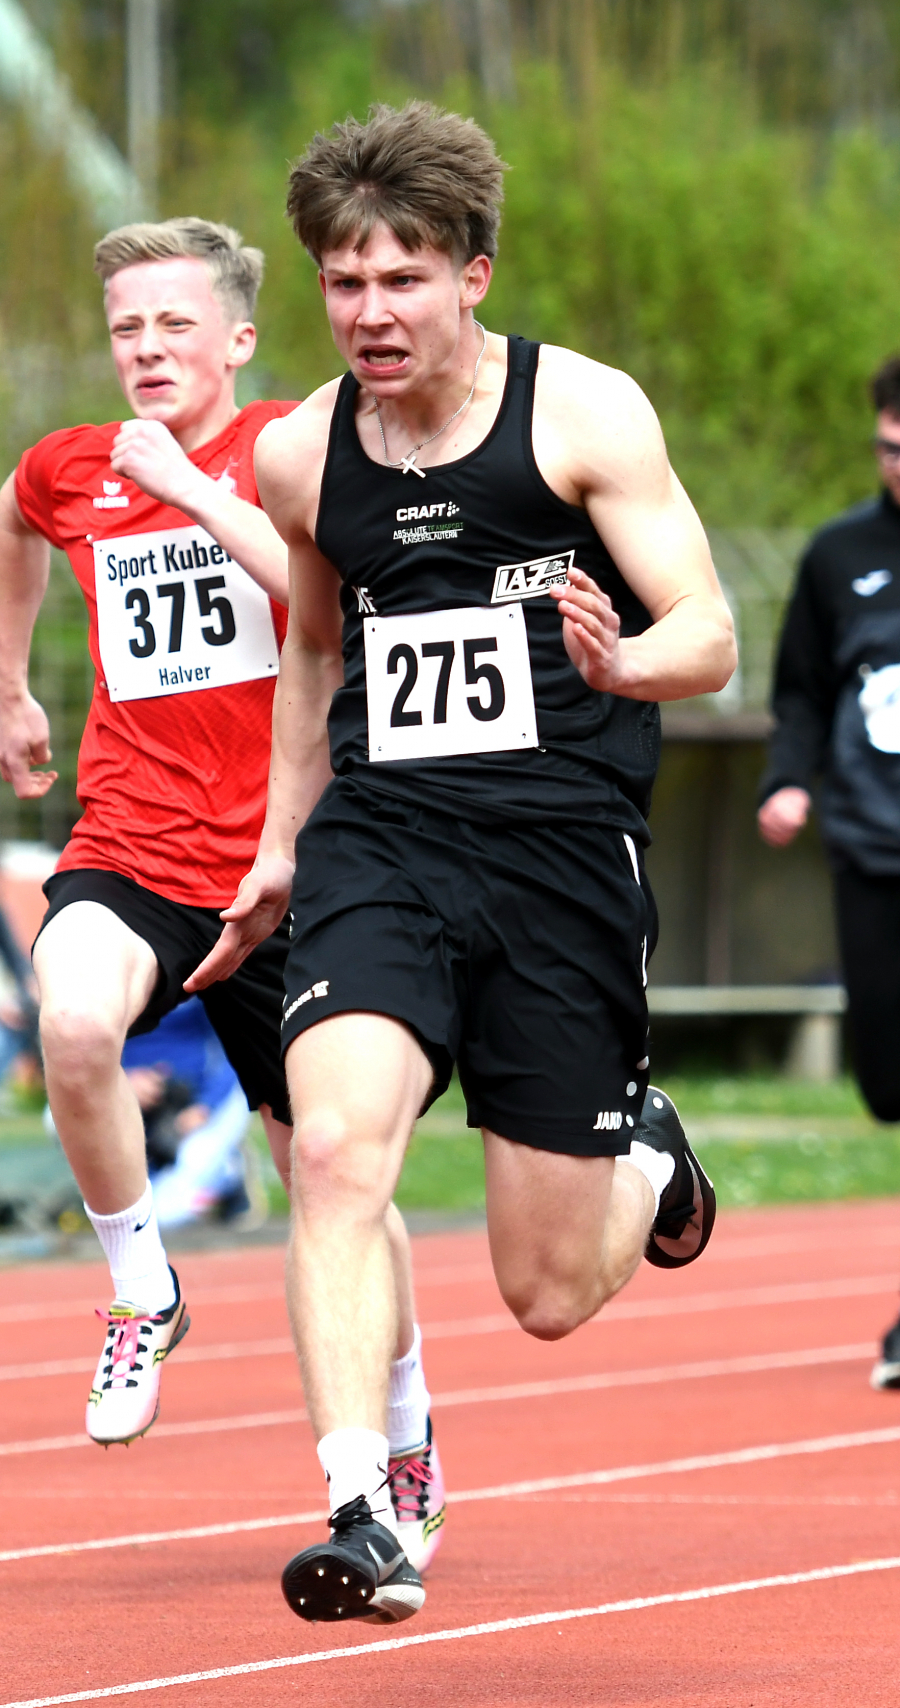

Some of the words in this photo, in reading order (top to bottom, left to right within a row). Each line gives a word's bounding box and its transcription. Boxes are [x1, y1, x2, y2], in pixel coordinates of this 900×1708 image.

[396, 503, 446, 521] CRAFT
[107, 550, 158, 586] Sport
[125, 575, 237, 658] 375
[159, 665, 211, 686] Halver
[387, 637, 506, 728] 275
[593, 1111, 623, 1130] JAKO
